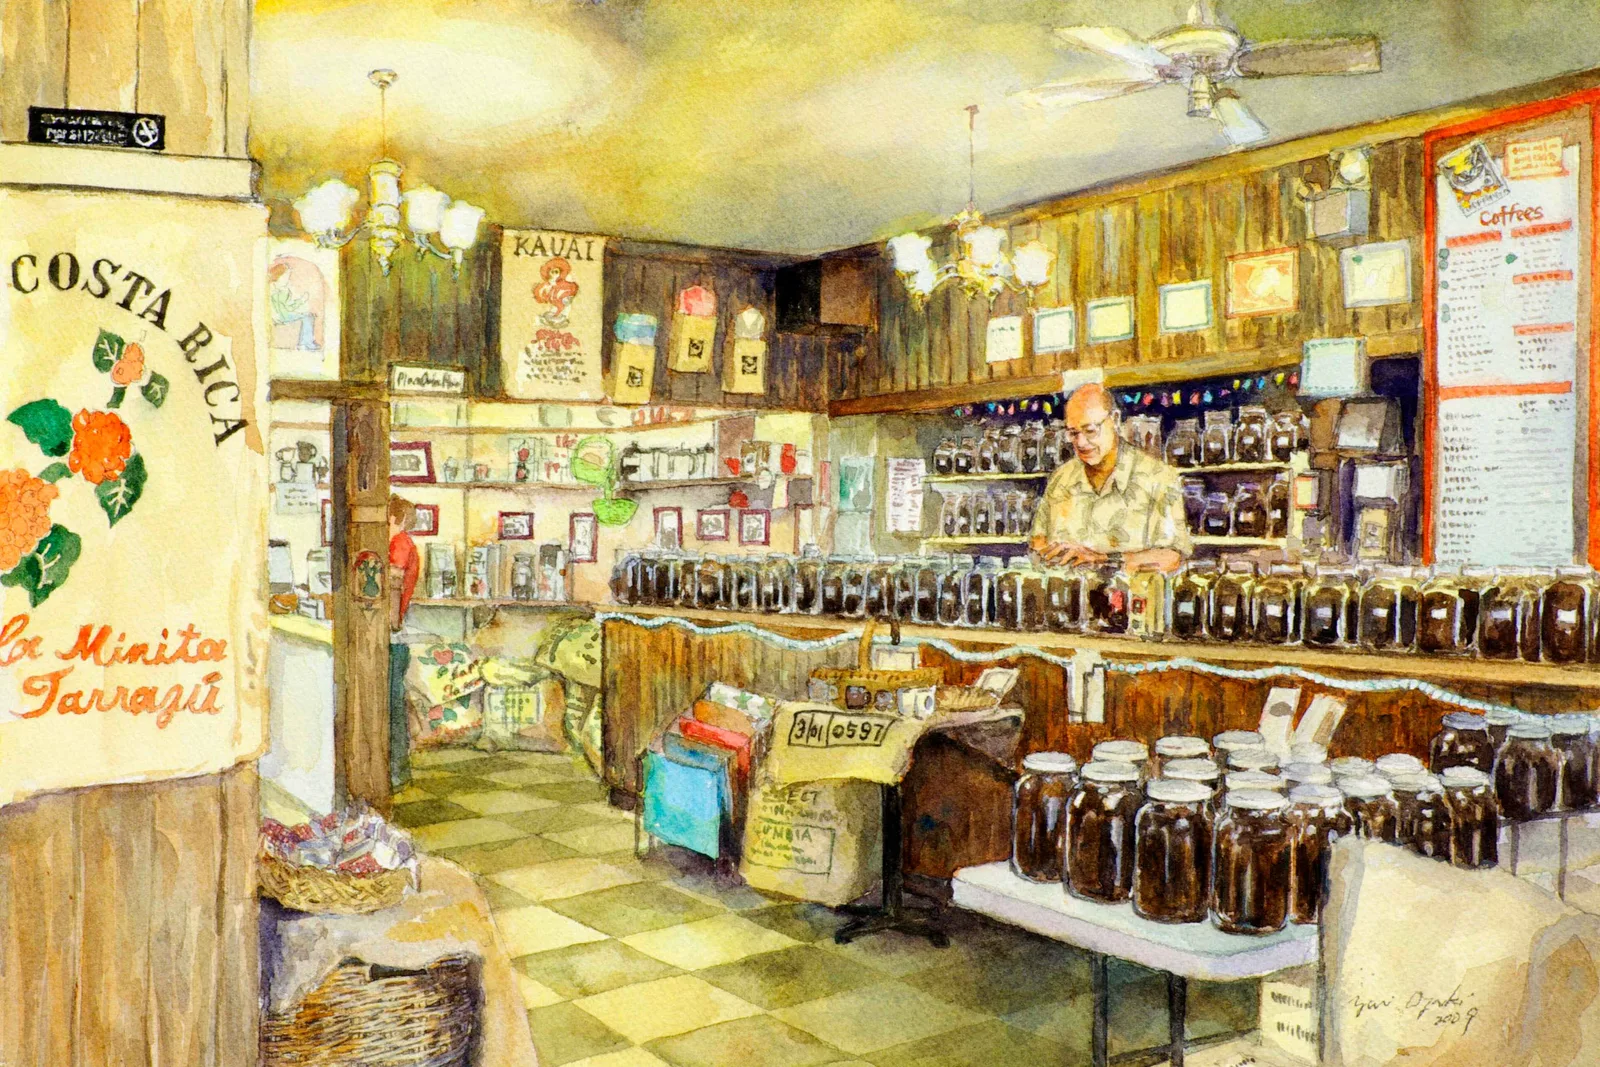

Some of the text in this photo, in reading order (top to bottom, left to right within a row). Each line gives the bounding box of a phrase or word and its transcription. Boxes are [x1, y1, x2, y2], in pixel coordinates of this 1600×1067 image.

[1480, 204, 1545, 226] Coffees
[513, 236, 595, 262] KAUAI
[11, 252, 249, 447] COSTA RICA
[55, 623, 227, 667] Minita
[1434, 1007, 1479, 1037] 2009
